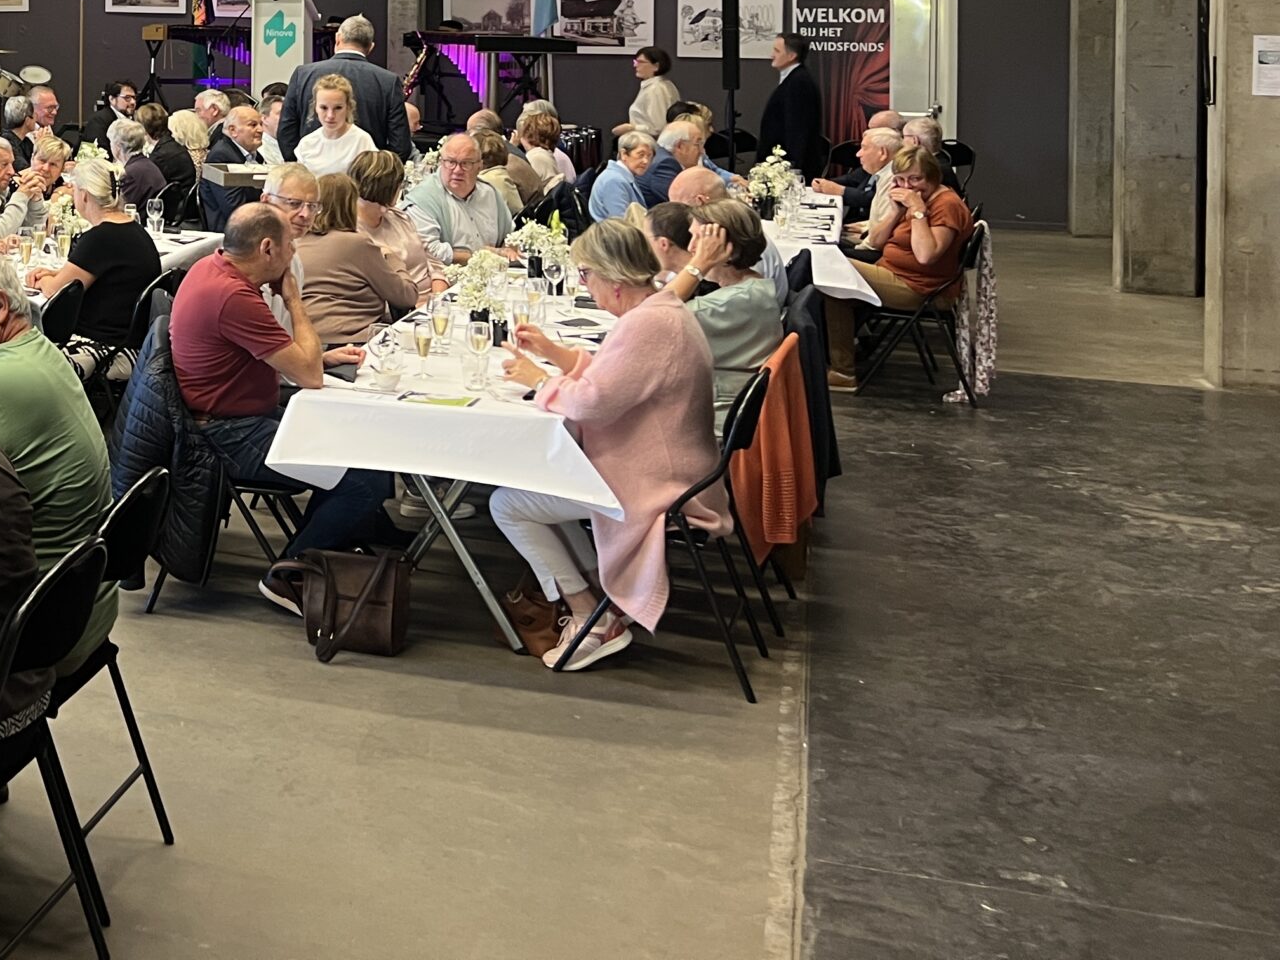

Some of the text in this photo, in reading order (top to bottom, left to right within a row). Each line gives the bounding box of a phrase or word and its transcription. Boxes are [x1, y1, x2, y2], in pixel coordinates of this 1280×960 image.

[795, 7, 885, 23] WELKOM
[265, 29, 294, 37] Ninove
[800, 27, 843, 37] BIJ HET
[808, 41, 885, 52] AVIDSFONDS
